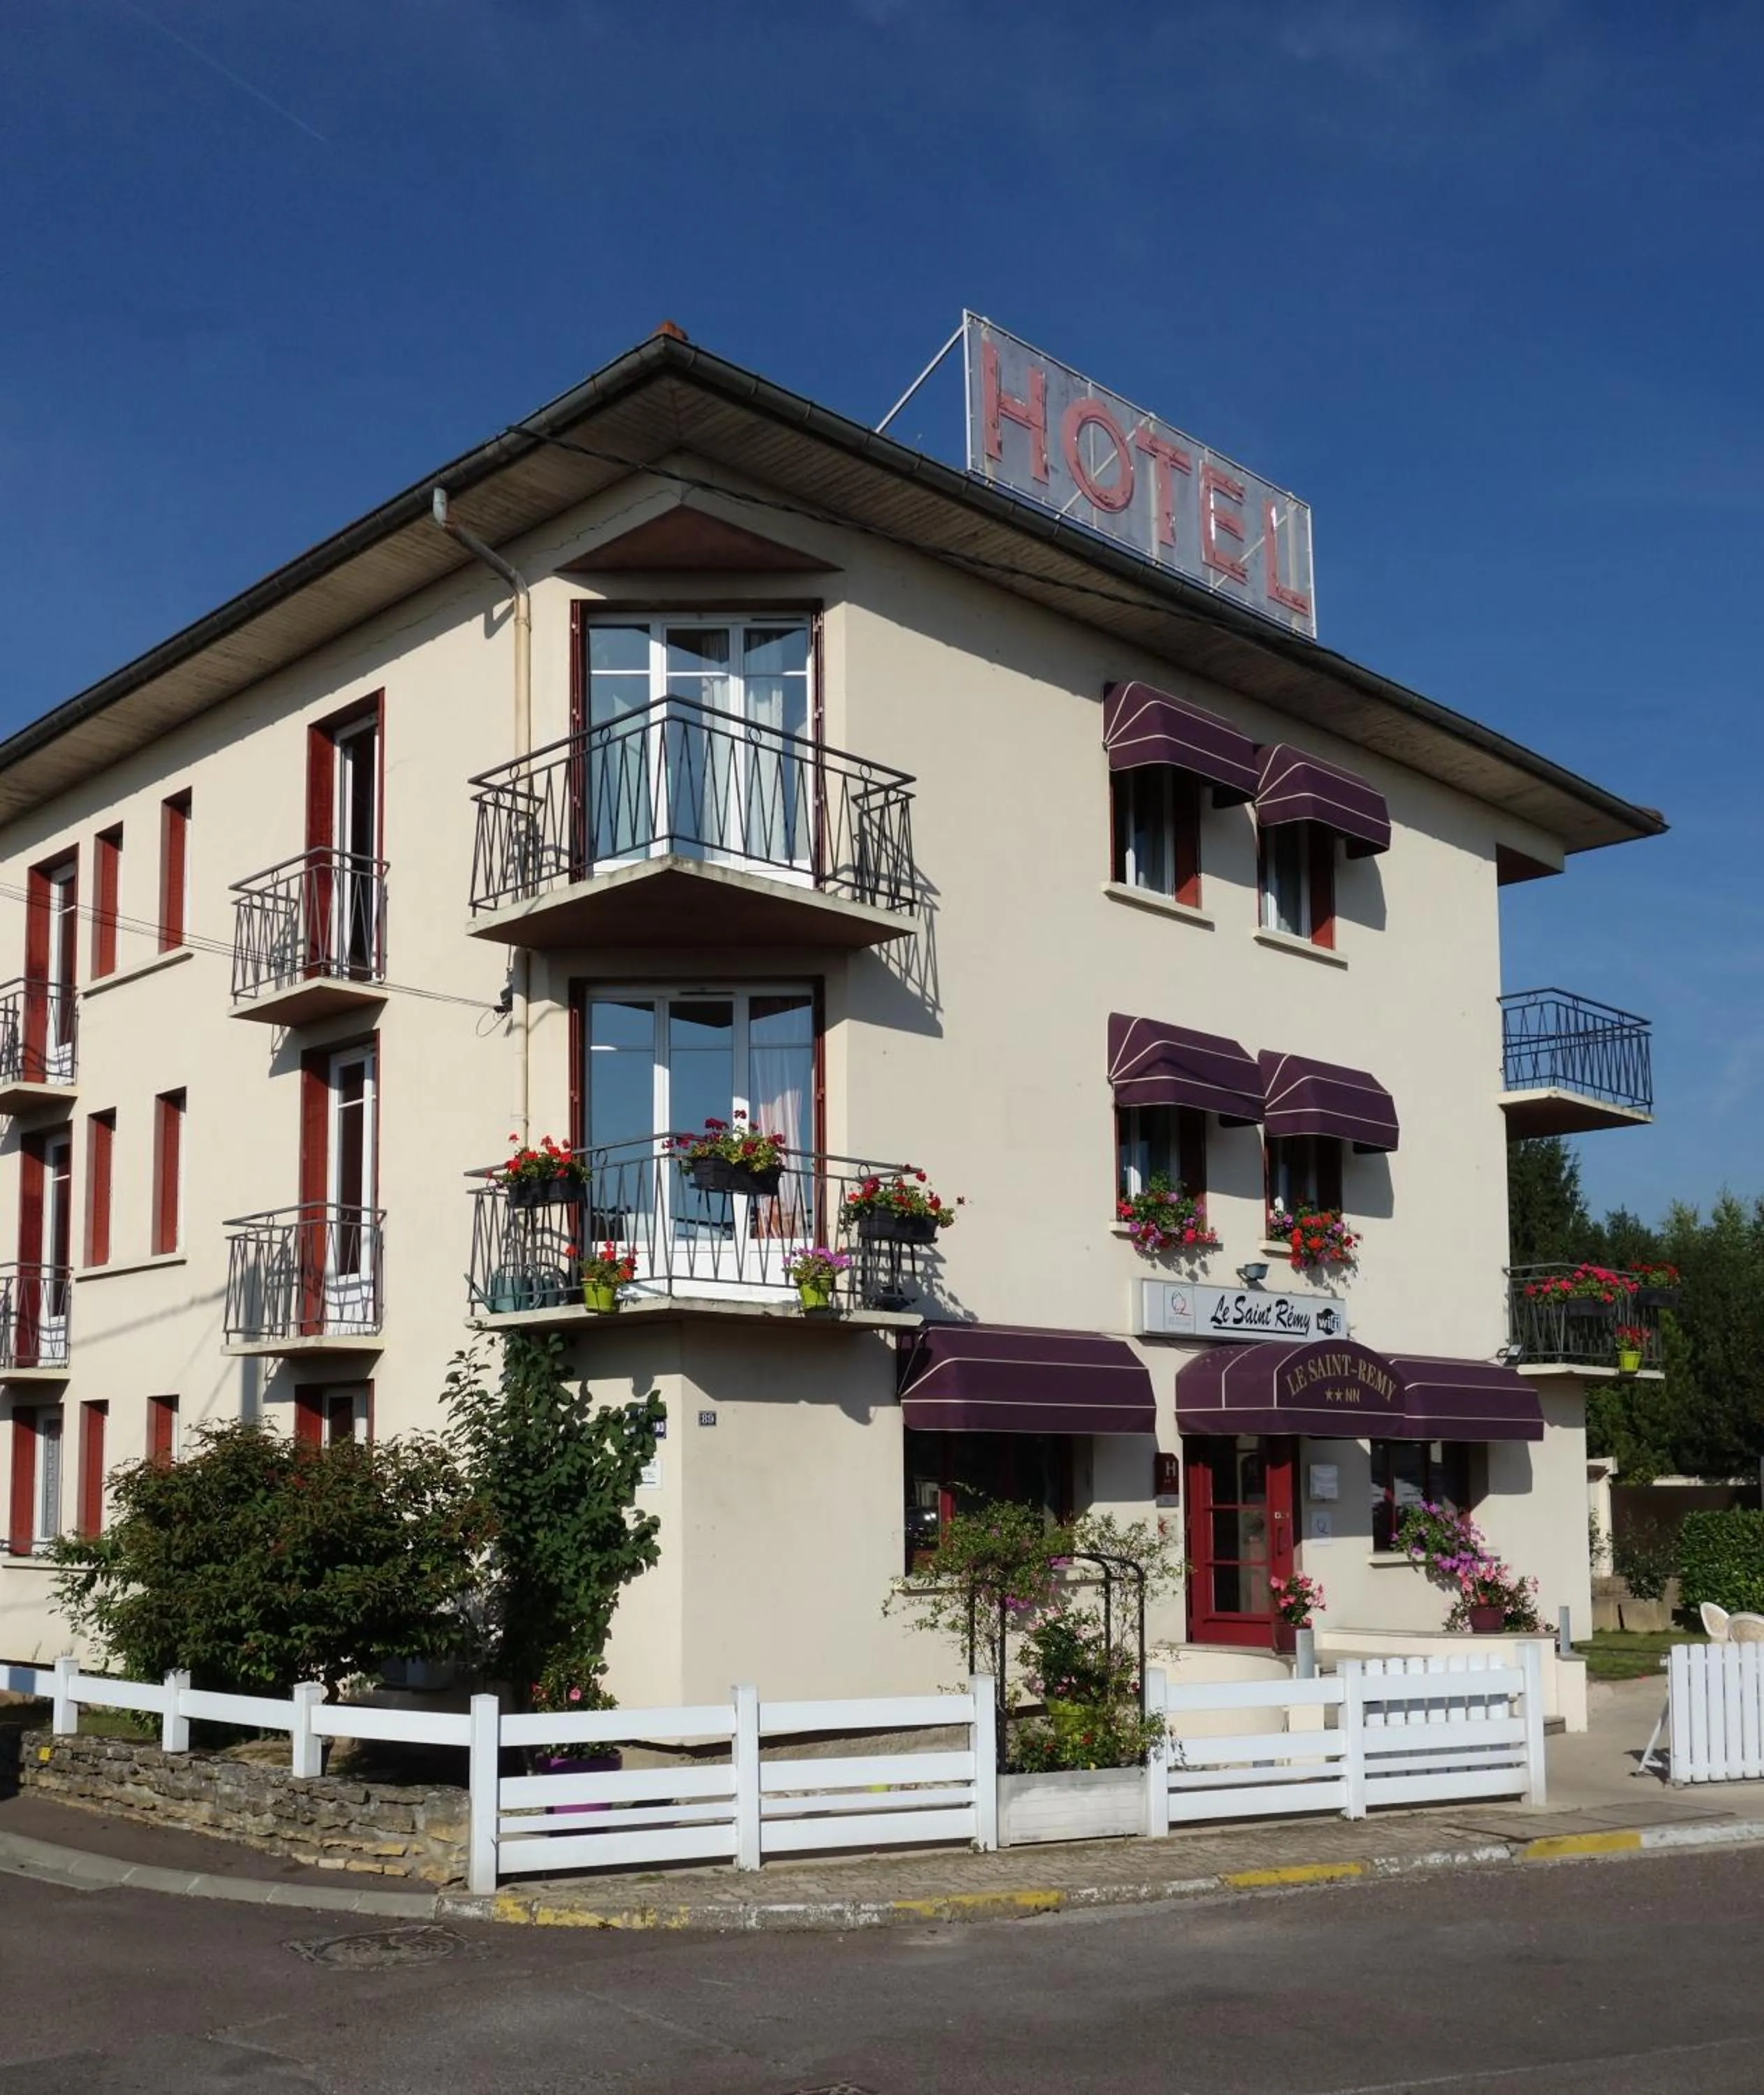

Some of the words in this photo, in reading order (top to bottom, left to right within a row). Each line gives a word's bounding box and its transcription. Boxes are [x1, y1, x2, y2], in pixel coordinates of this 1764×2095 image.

[982, 339, 1310, 617] HOTEL
[1210, 1294, 1230, 1325] Le
[1233, 1295, 1272, 1325] Saint
[1275, 1298, 1311, 1336] Rémy
[1286, 1365, 1308, 1397] LE
[1307, 1353, 1397, 1402] SAINT-REMY
[701, 1413, 714, 1425] 89
[1166, 1460, 1176, 1477] H
